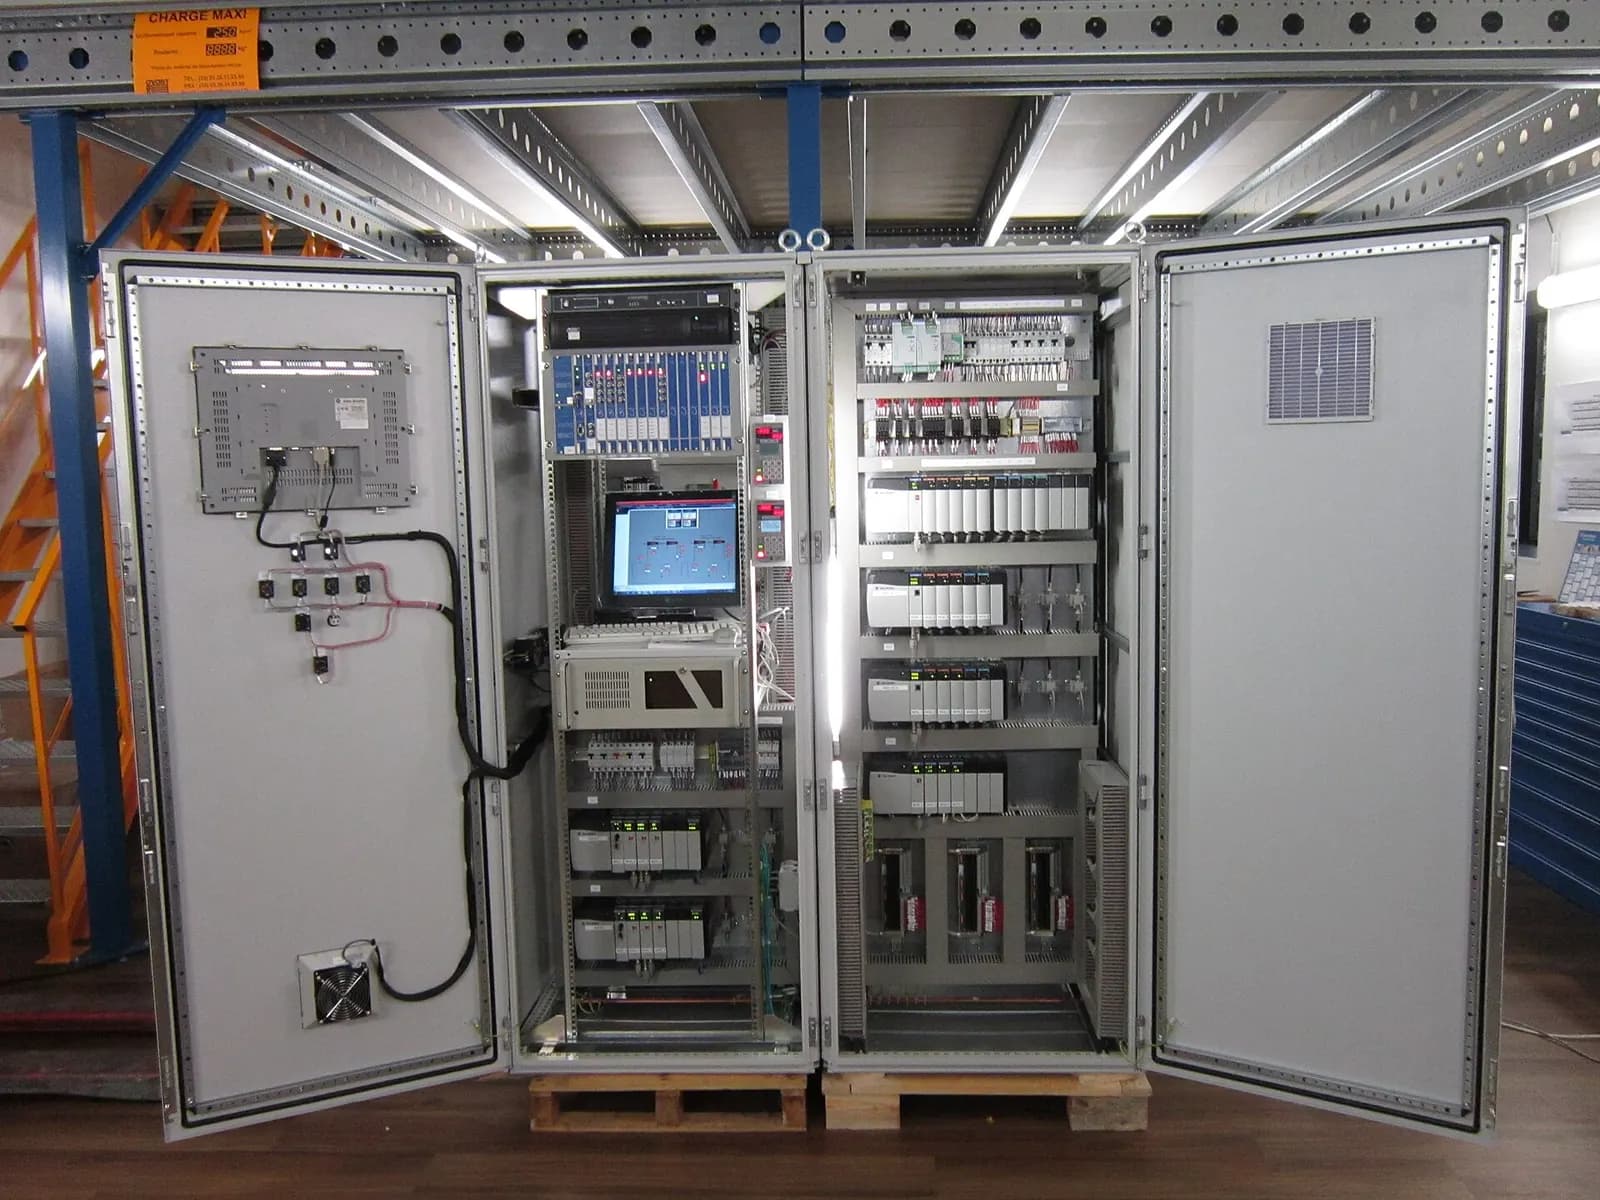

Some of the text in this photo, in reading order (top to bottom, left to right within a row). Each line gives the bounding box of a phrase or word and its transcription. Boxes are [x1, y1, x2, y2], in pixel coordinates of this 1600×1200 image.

[149, 8, 247, 23] CHARGE MAXI
[213, 27, 236, 38] 250
